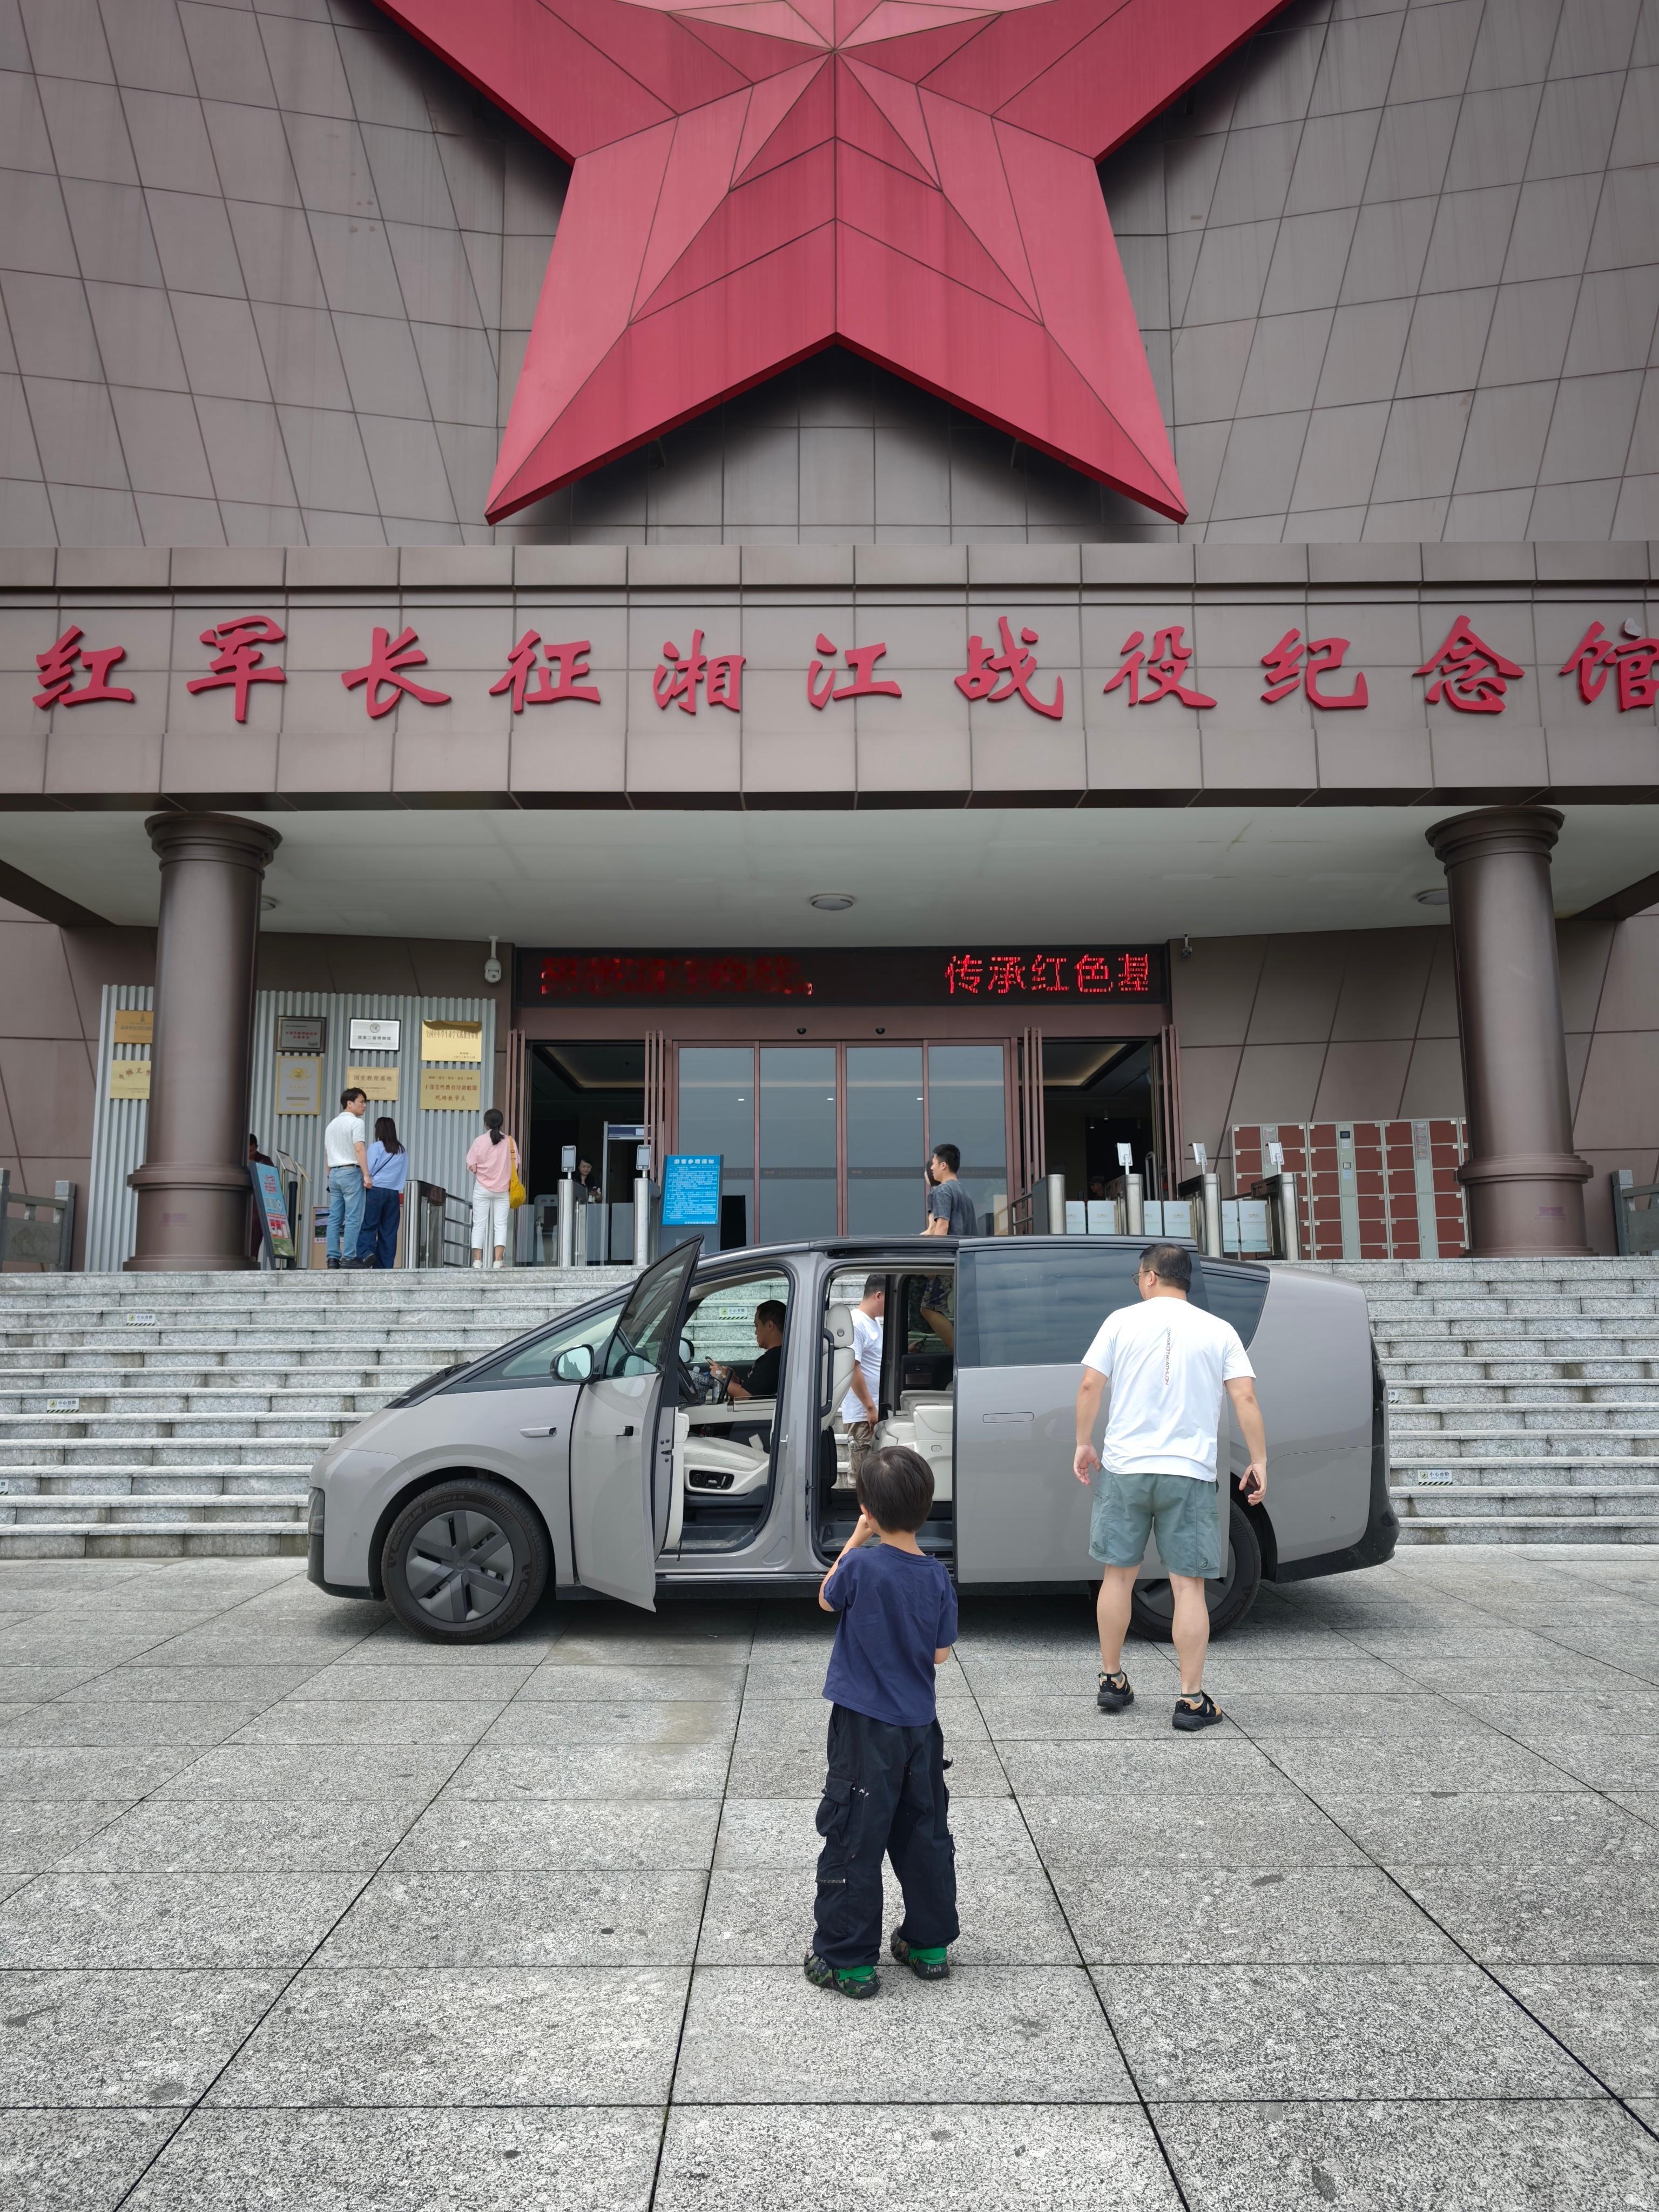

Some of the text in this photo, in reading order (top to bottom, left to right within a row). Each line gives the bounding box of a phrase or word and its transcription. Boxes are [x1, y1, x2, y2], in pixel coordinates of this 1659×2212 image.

[31, 615, 1659, 724] 红军长征湘江战役纪念馆
[945, 953, 1149, 994] 传承红色基
[392, 1506, 423, 1551] MICHELIN
[497, 1580, 528, 1628] MICHELIN
